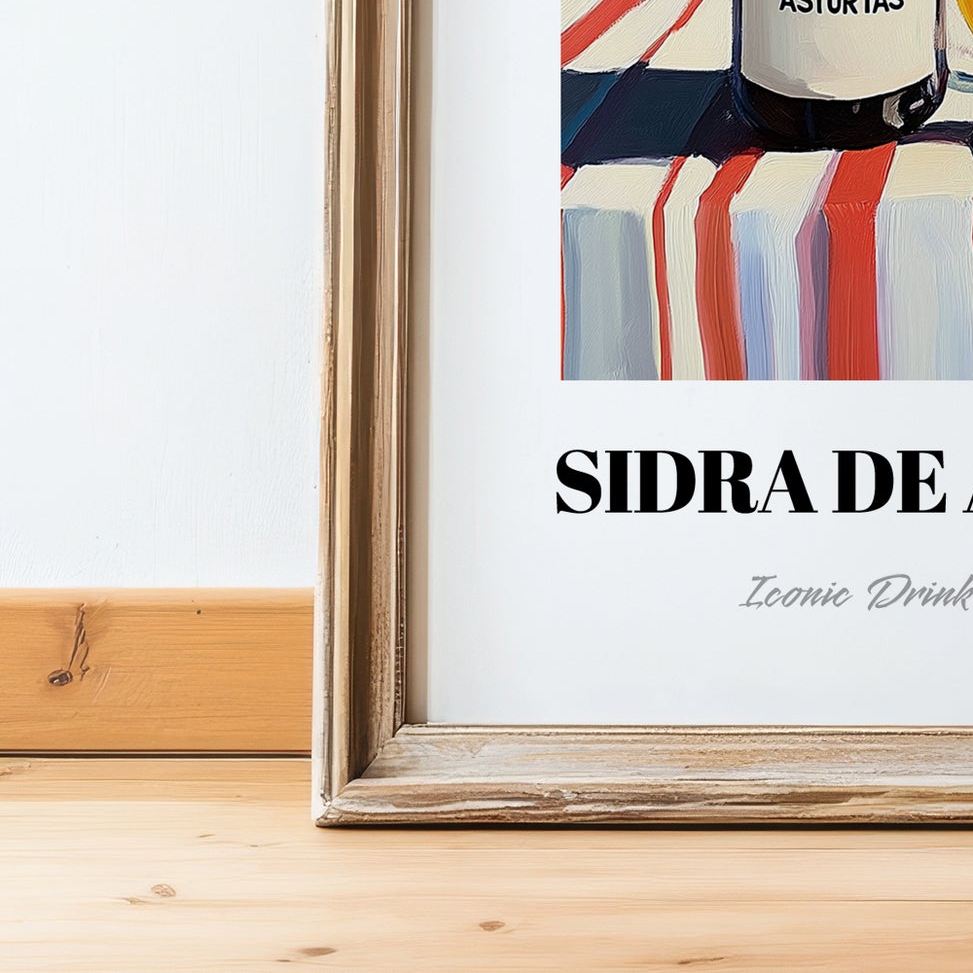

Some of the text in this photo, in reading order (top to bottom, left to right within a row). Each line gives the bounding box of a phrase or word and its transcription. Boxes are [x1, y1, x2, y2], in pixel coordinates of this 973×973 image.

[555, 449, 818, 515] SIDRA
[832, 450, 946, 514] DE
[737, 574, 854, 610] Iconic
